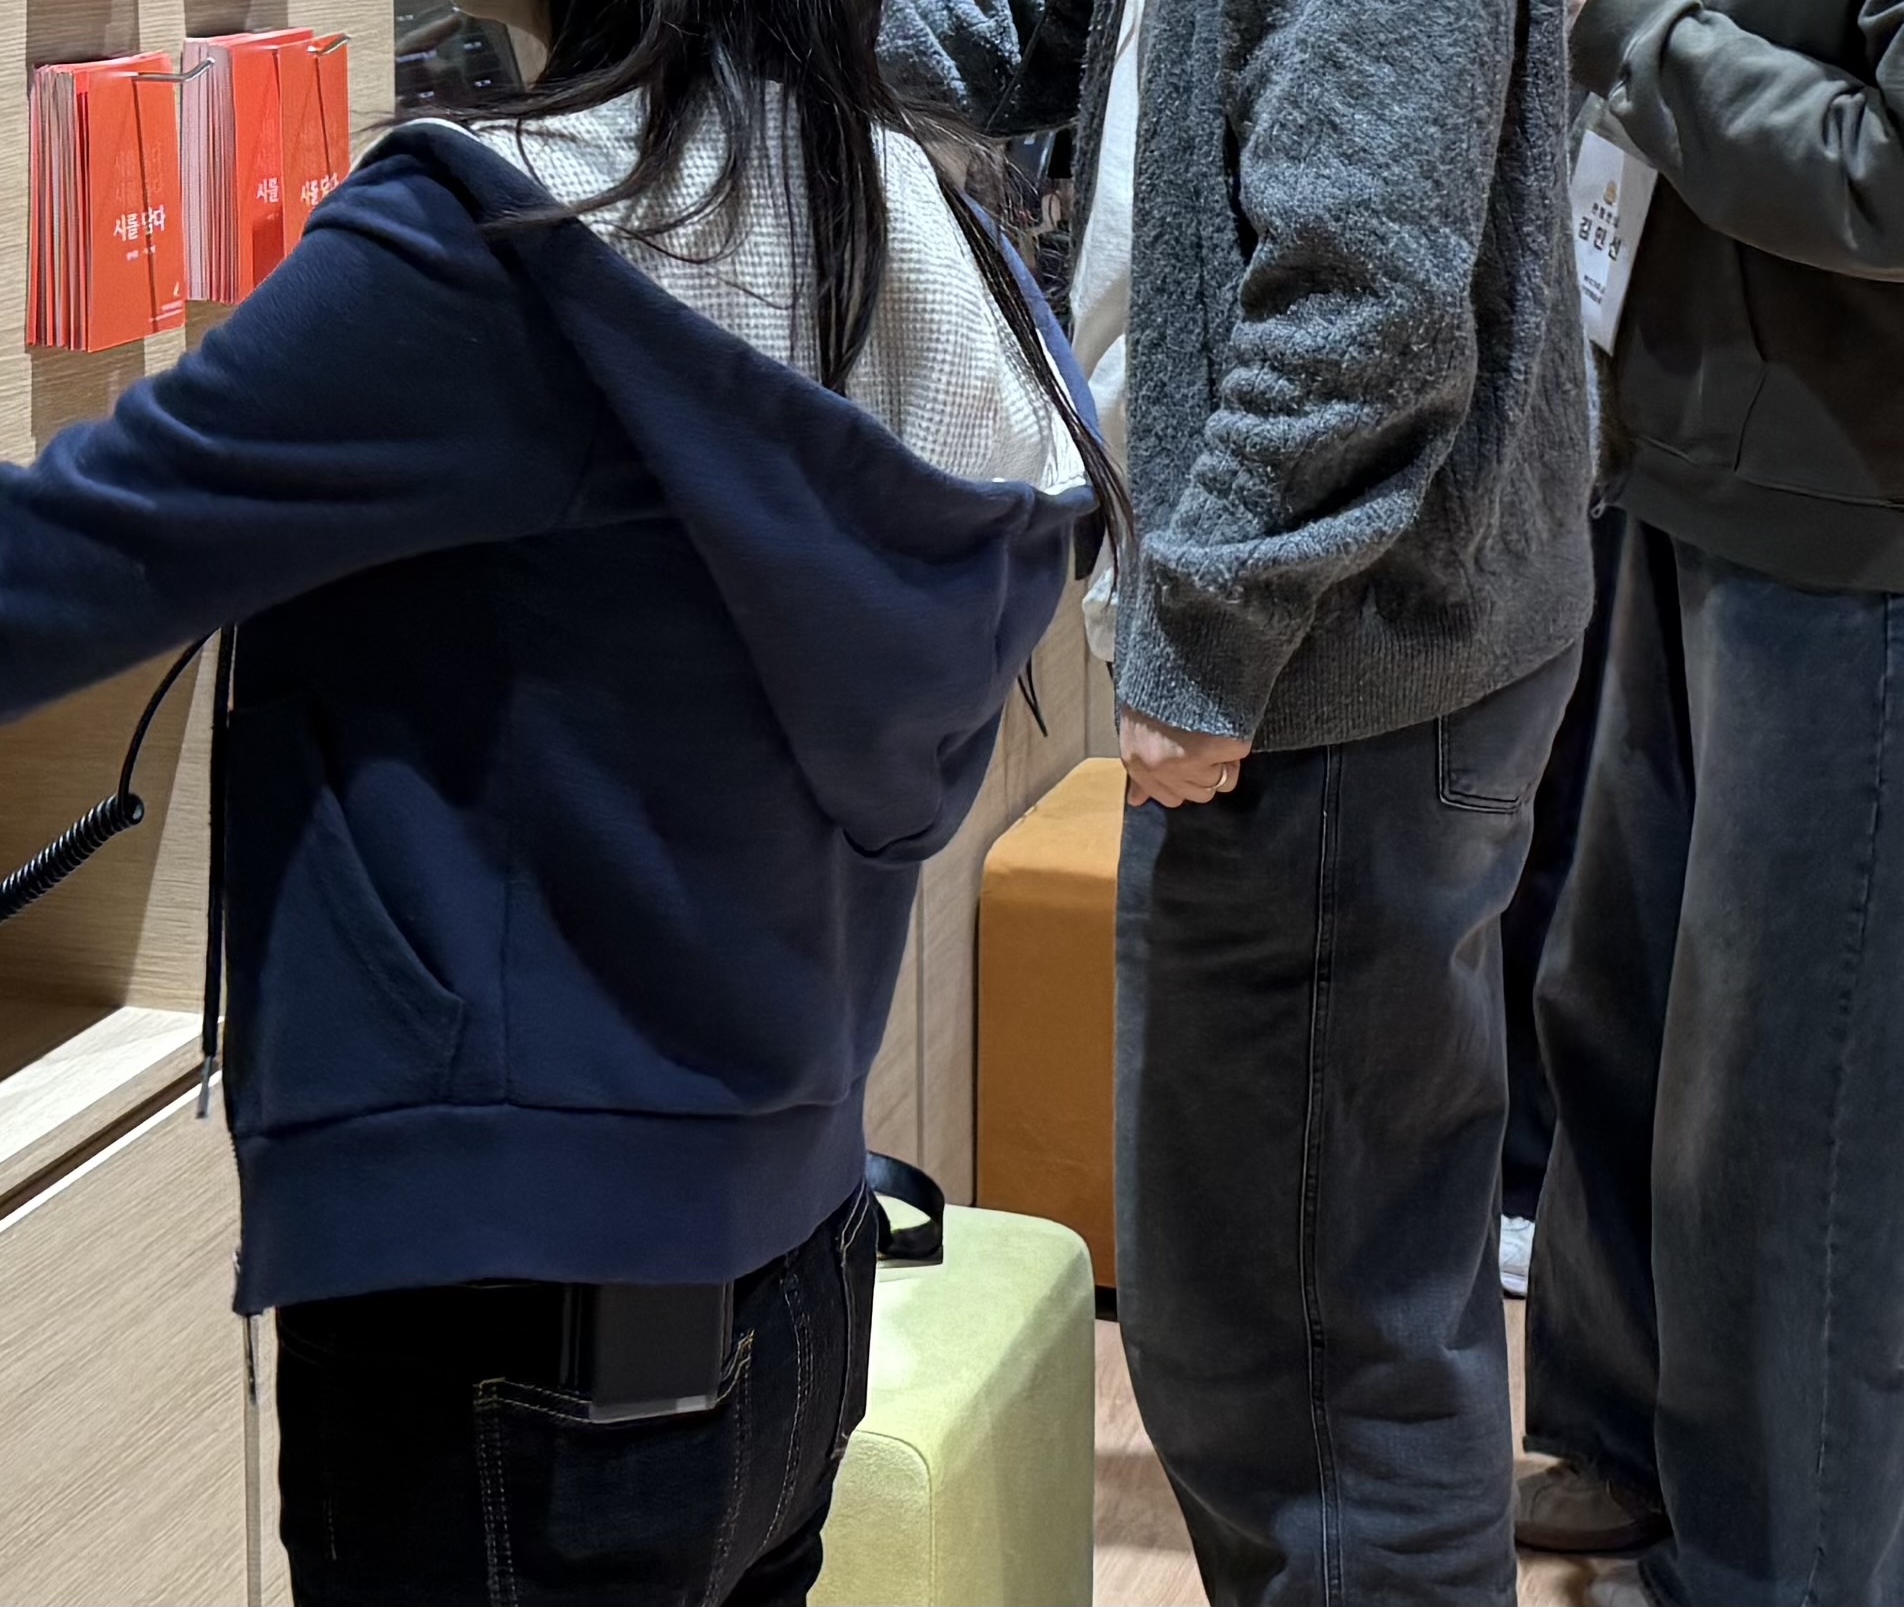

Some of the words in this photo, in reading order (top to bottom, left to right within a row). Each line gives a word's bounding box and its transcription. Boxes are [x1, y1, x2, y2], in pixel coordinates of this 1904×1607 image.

[257, 177, 279, 204] 시를
[300, 179, 319, 207] 시를
[113, 212, 140, 242] 시를
[141, 204, 167, 236] 담다
